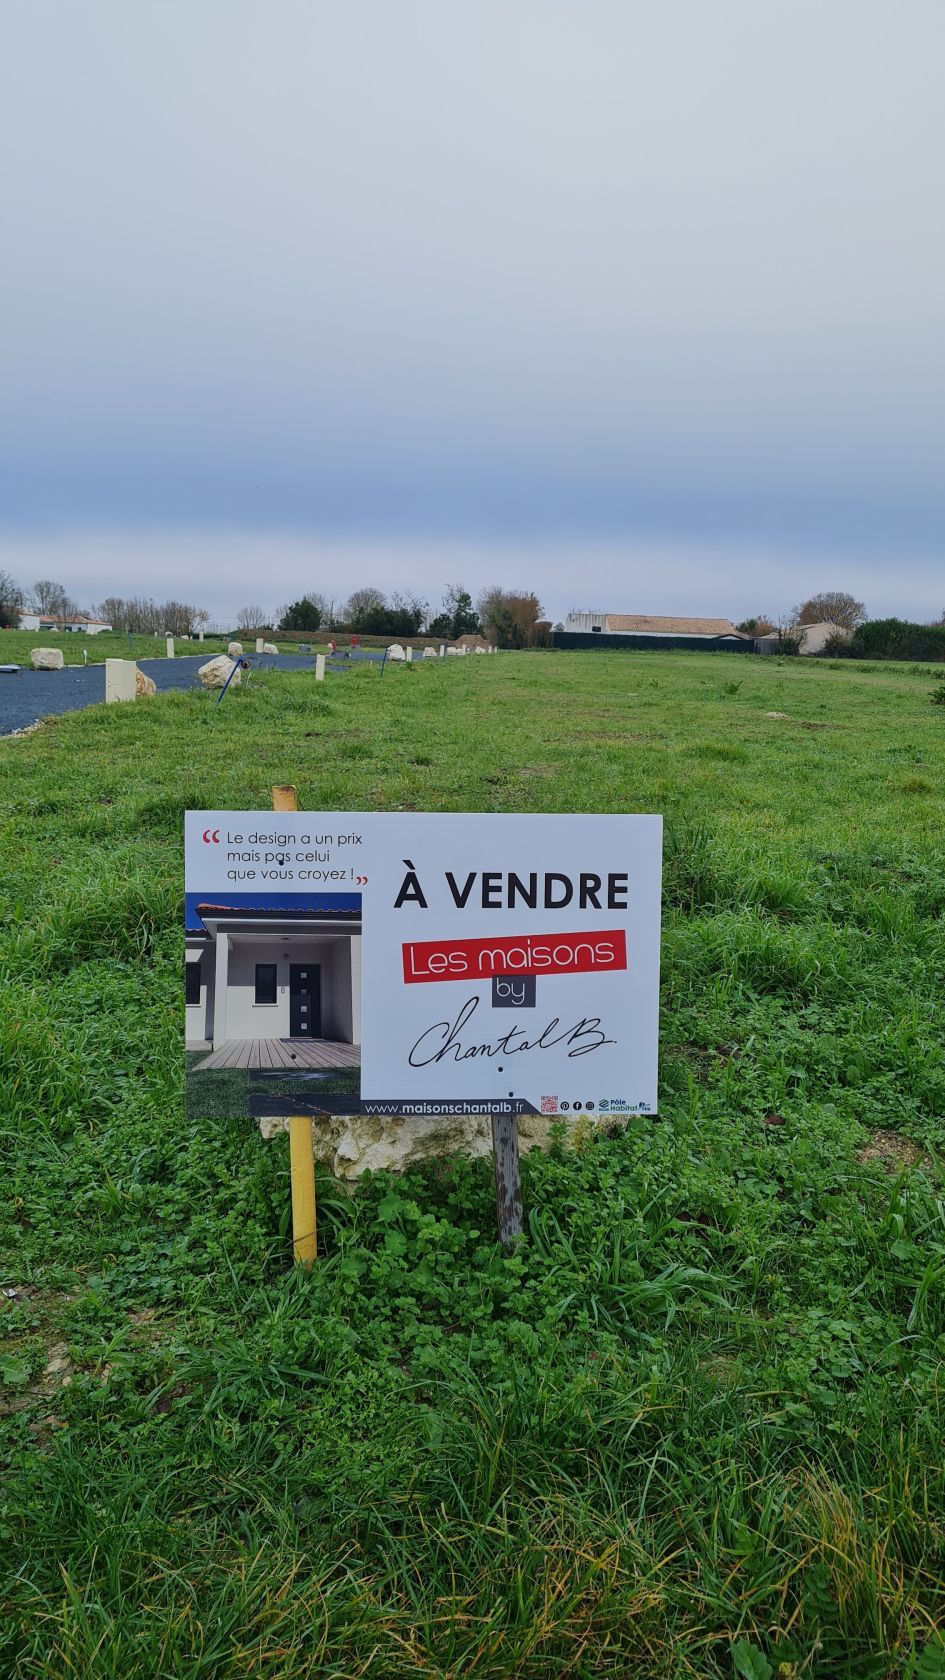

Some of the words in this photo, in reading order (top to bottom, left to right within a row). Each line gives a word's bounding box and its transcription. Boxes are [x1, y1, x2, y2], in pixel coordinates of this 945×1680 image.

[227, 832, 243, 844] Le
[248, 832, 296, 847] design
[301, 834, 311, 844] a
[315, 834, 333, 844] un
[337, 832, 363, 847] prix
[227, 850, 260, 862] mais
[265, 852, 291, 864] pas
[295, 850, 330, 862] celui
[226, 870, 256, 882] que
[261, 870, 294, 880] vous
[298, 870, 347, 882] croyez
[393, 859, 429, 909] À
[445, 872, 629, 909] VENDRE
[410, 946, 468, 975] Les
[478, 938, 615, 970] maisons
[496, 976, 526, 1005] by
[408, 995, 560, 1068] Chantal
[365, 1101, 524, 1114] www.maisonschantalb.fr
